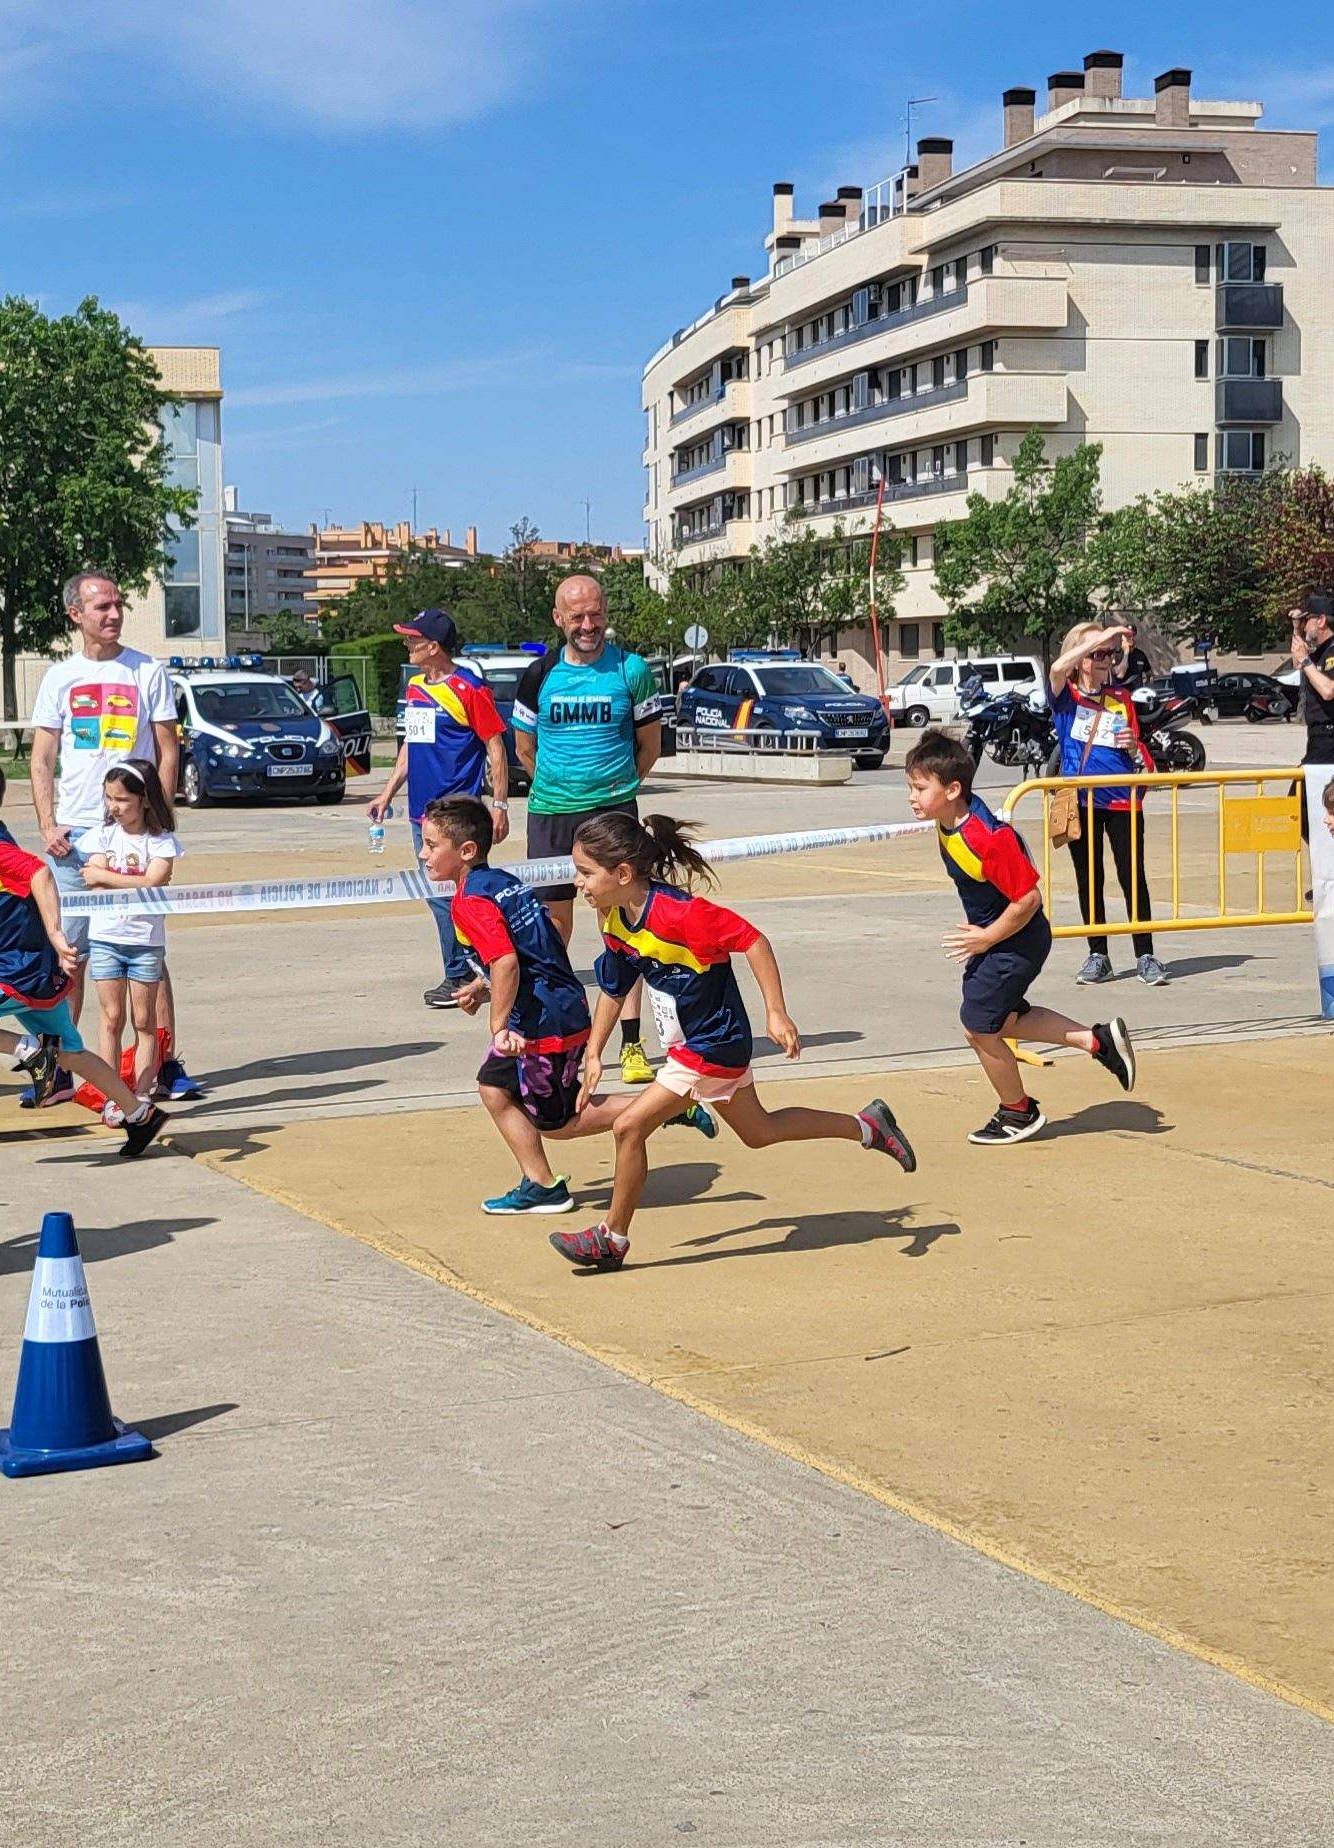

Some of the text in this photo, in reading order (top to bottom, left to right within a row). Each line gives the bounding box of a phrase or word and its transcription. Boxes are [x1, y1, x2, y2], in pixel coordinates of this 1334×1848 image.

[550, 702, 612, 724] GMMB
[696, 706, 723, 718] POLICIA
[695, 716, 730, 729] NACIONAL
[246, 734, 318, 745] POLICIA
[41, 1297, 54, 1310] de
[56, 1298, 67, 1310] la
